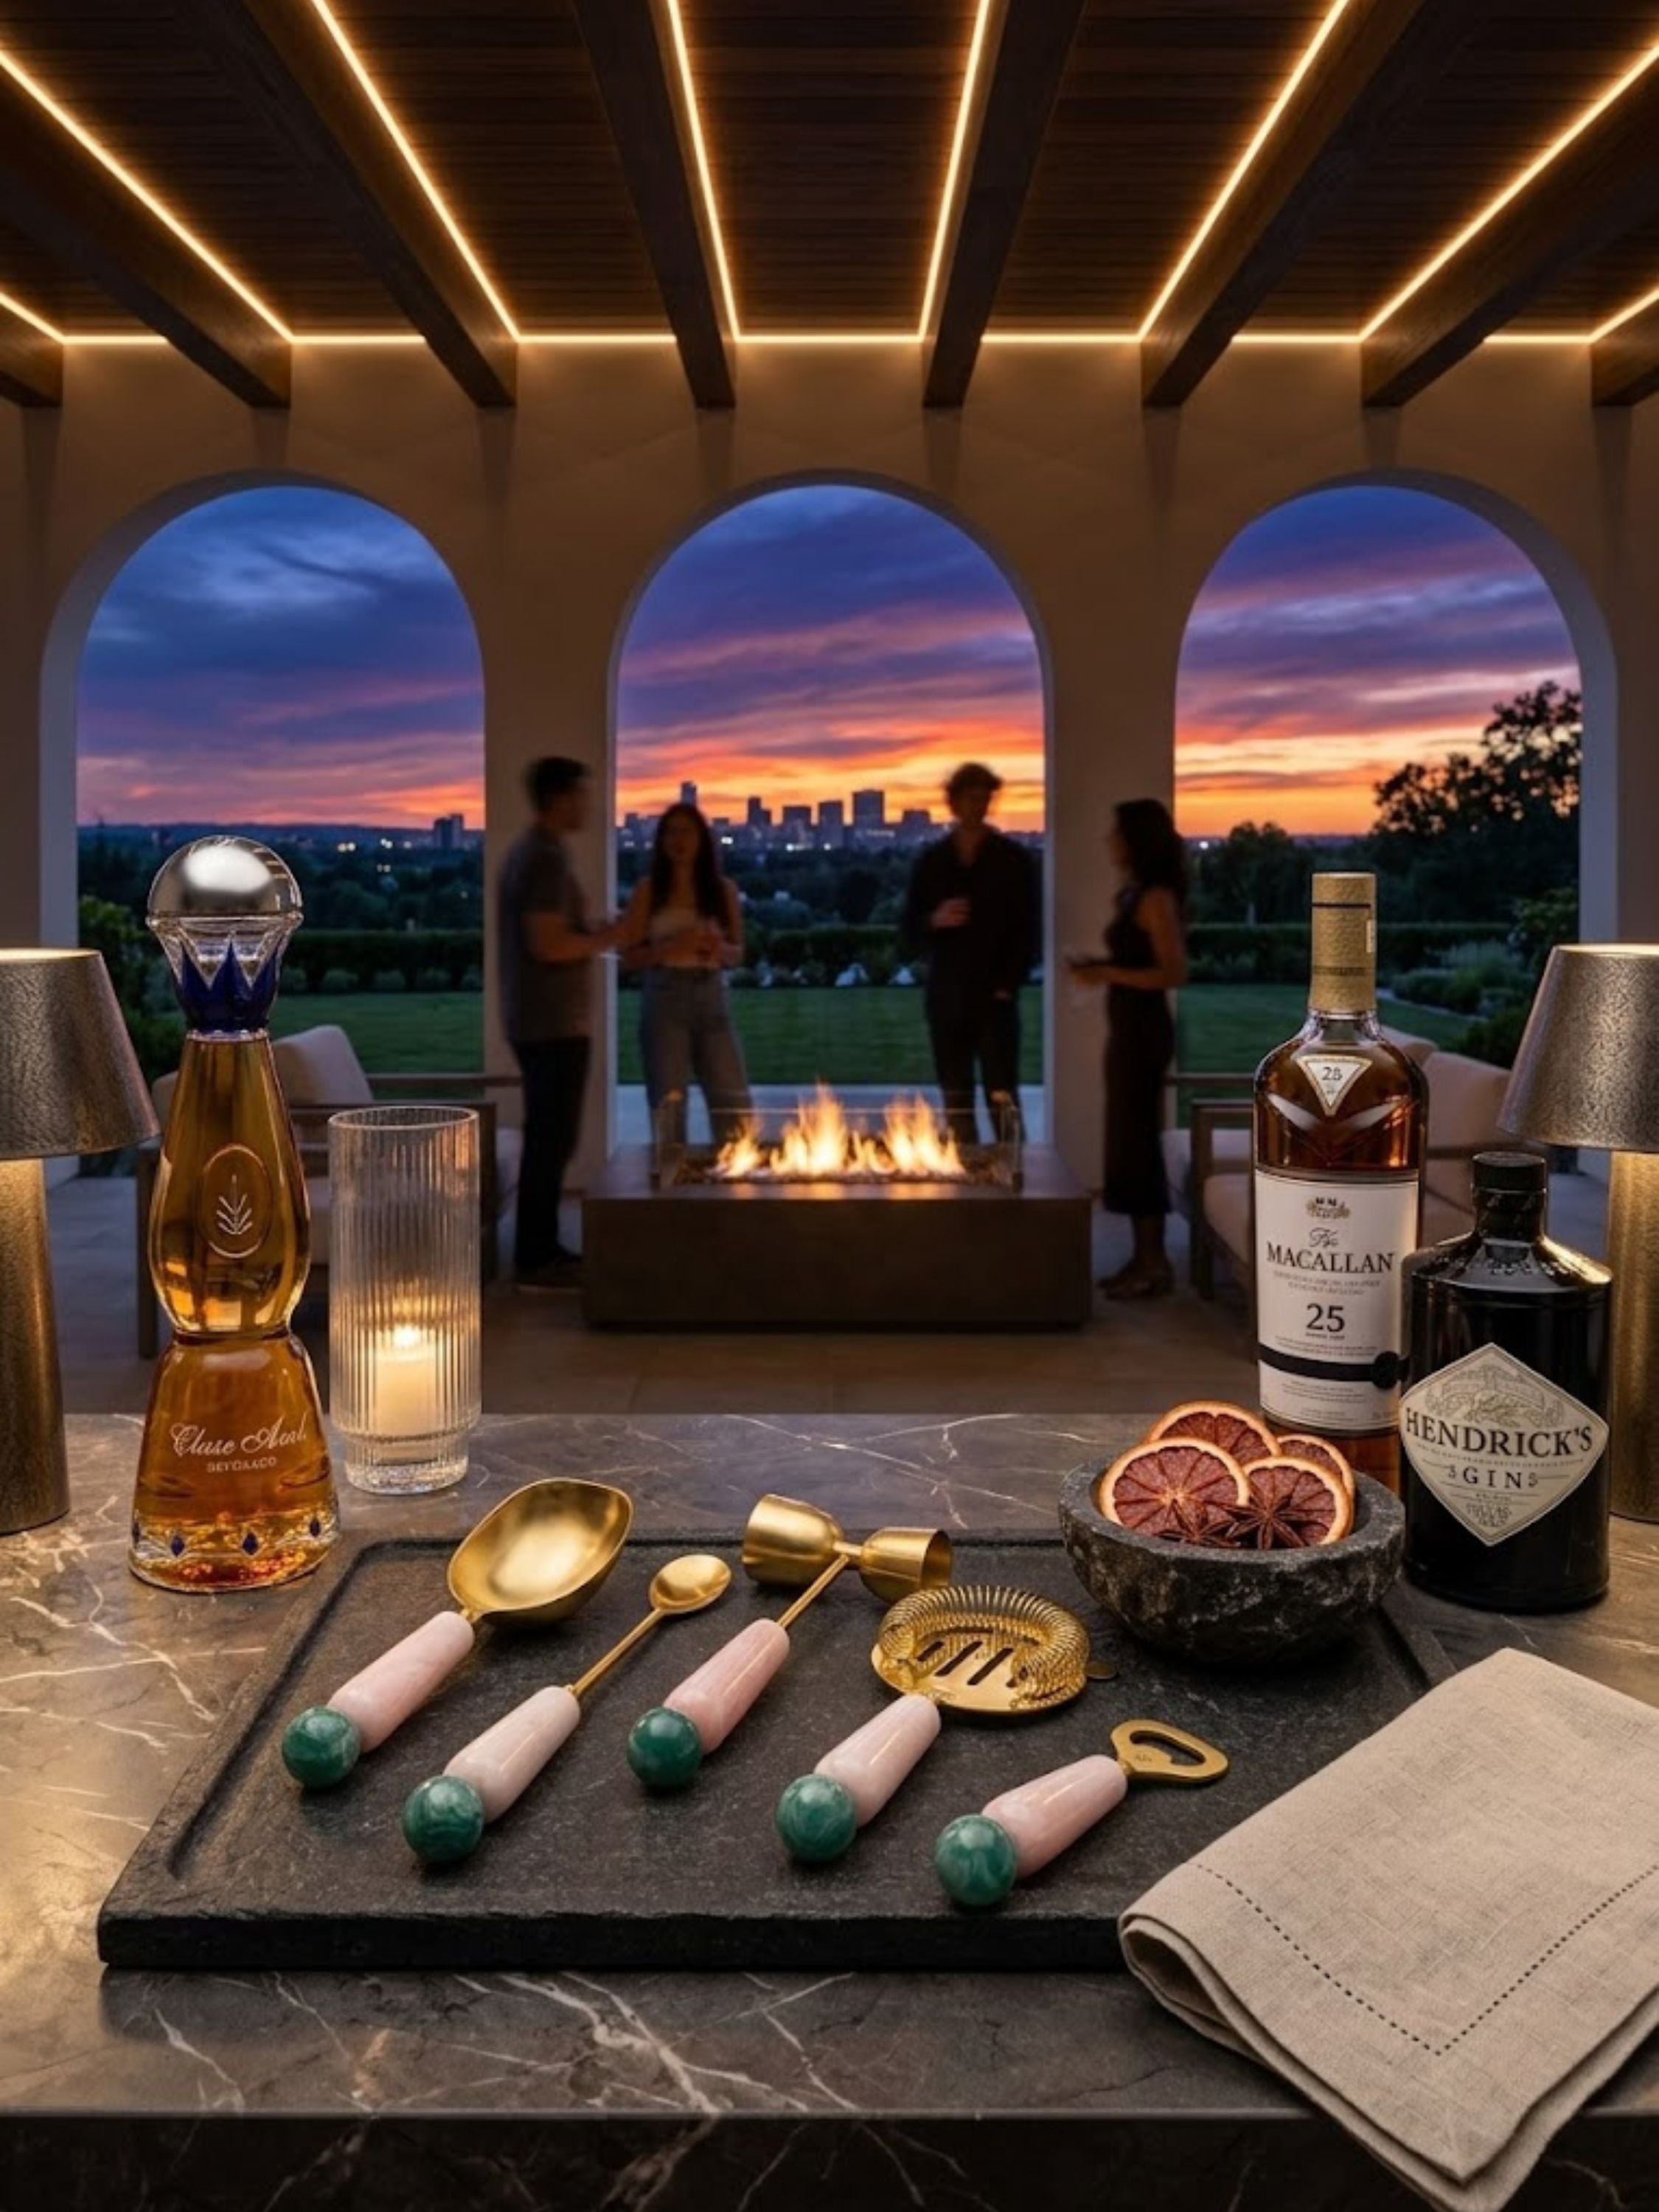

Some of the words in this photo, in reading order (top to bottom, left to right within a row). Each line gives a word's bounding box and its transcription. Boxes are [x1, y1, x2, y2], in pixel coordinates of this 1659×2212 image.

[1266, 1240, 1394, 1274] MACALLAN
[1306, 1302, 1345, 1333] 25
[1405, 1406, 1593, 1458] HENDRICK'S
